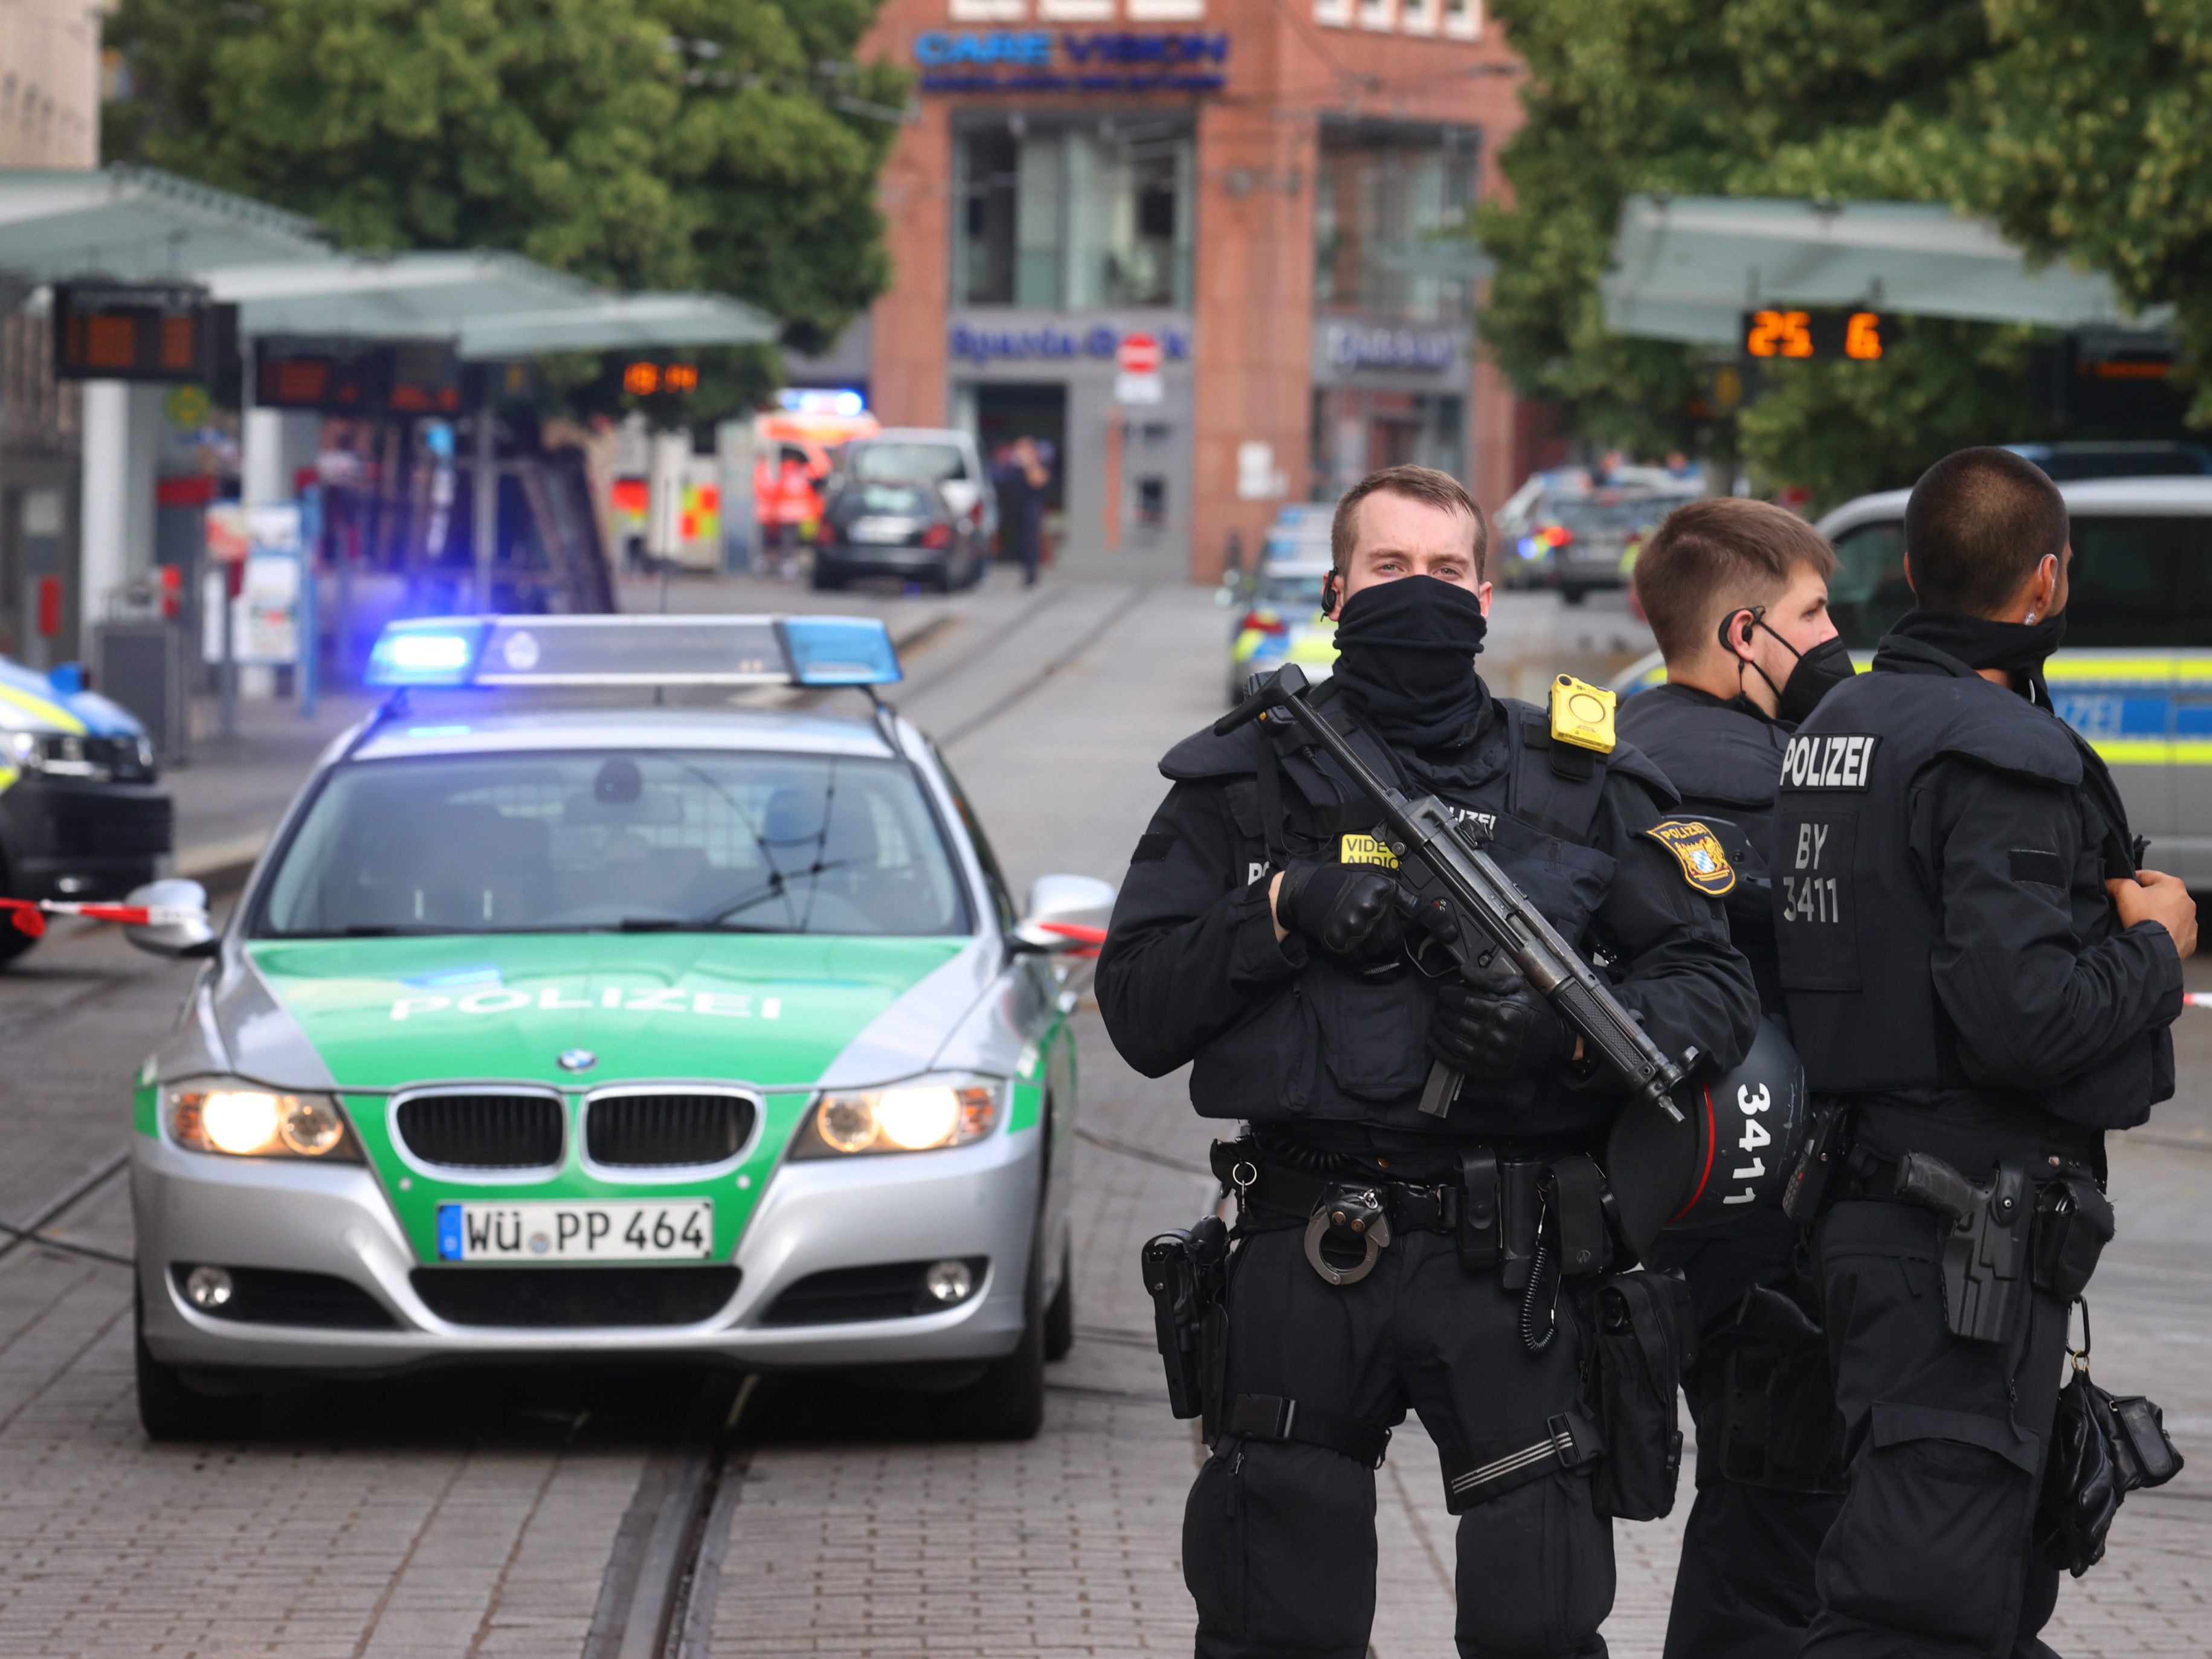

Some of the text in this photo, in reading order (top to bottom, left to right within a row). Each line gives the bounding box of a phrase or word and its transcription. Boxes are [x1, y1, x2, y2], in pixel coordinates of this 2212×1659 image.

[914, 30, 1229, 66] CARE VISION
[2055, 695, 2124, 738] IZEI
[1779, 736, 1874, 787] POLIZEI
[1346, 838, 1387, 853] VIDE
[1660, 825, 1707, 840] POLIZEI
[1795, 822, 1829, 870] BY
[1783, 876, 1839, 923] 3411
[389, 986, 782, 1021] POLIZEI
[1723, 1082, 1771, 1205] 3411
[467, 1211, 521, 1251] WÜ
[556, 1211, 610, 1251] PP
[624, 1209, 703, 1250] 464
